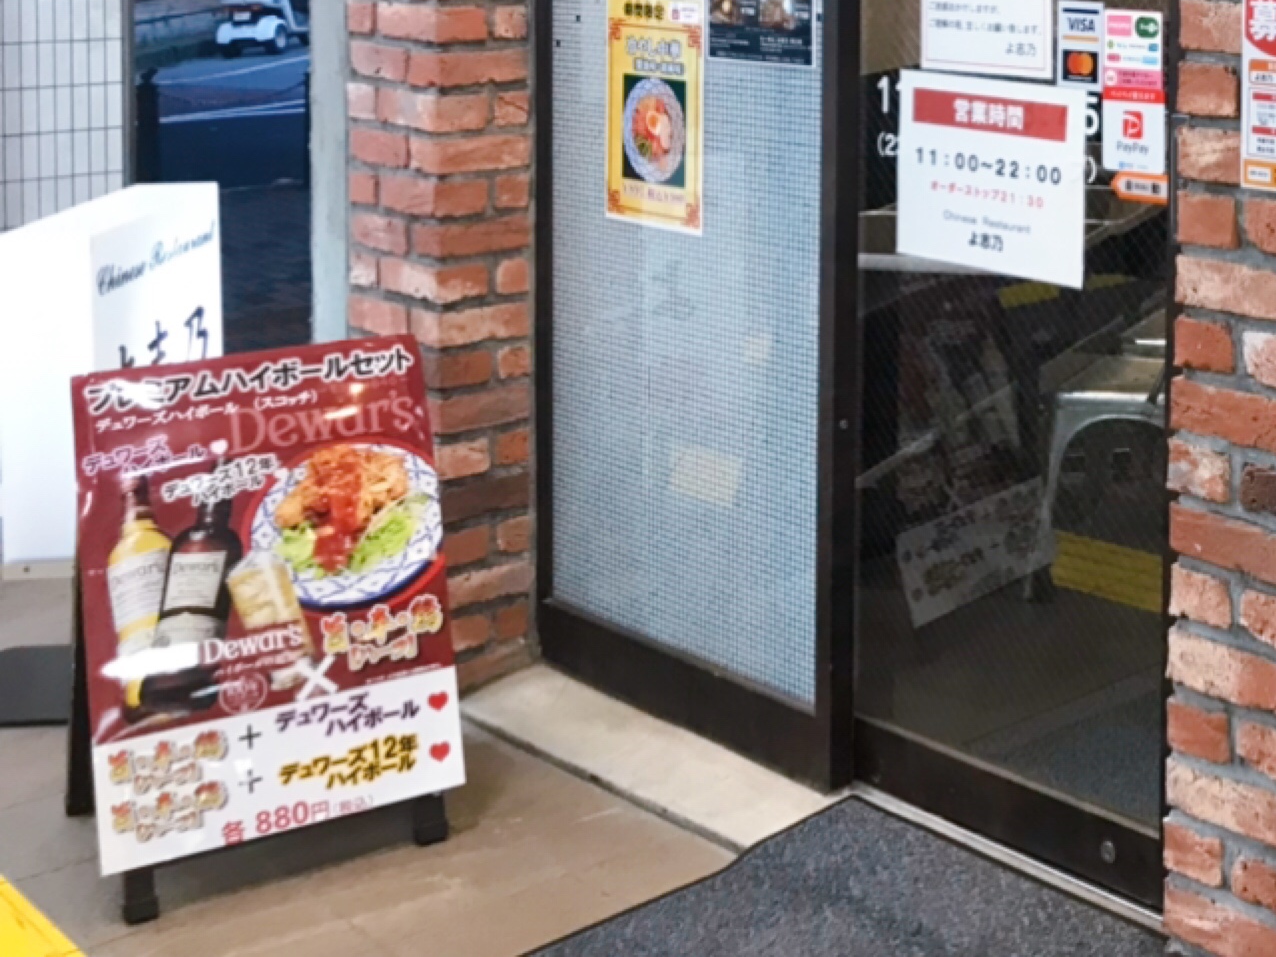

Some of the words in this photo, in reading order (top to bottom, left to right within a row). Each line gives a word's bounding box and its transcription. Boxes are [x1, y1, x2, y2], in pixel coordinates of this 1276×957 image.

[1067, 17, 1096, 33] VISA
[953, 97, 1025, 131] 営業時間
[1116, 140, 1149, 156] PayPay
[275, 692, 370, 732] デュワーズ
[325, 698, 421, 737] ハイボール
[278, 733, 419, 786] デュワーズ12年
[325, 753, 417, 790] ハイボール
